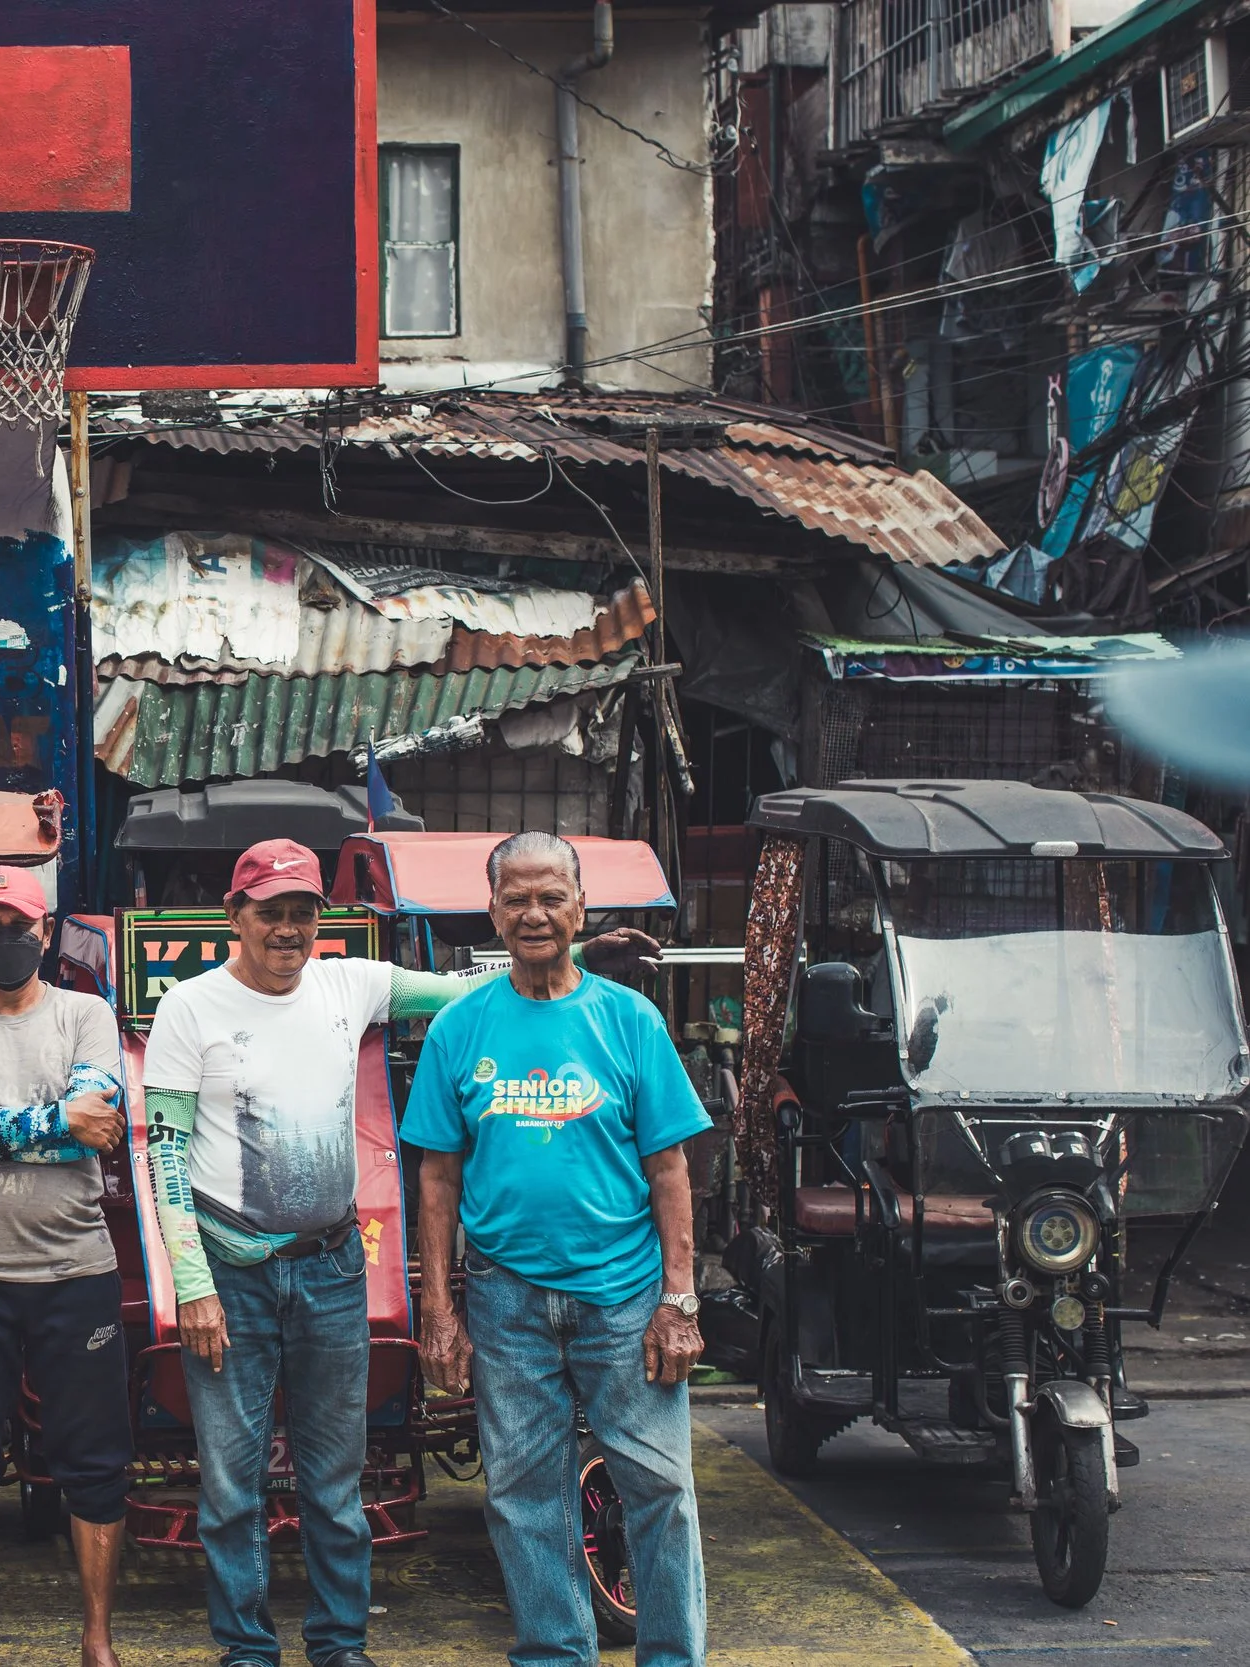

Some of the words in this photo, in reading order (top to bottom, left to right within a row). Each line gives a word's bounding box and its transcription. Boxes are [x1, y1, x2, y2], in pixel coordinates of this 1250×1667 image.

[492, 1079, 582, 1096] SENIOR
[490, 1097, 583, 1114] CITIZEN
[165, 1174, 181, 1205] YUYU
